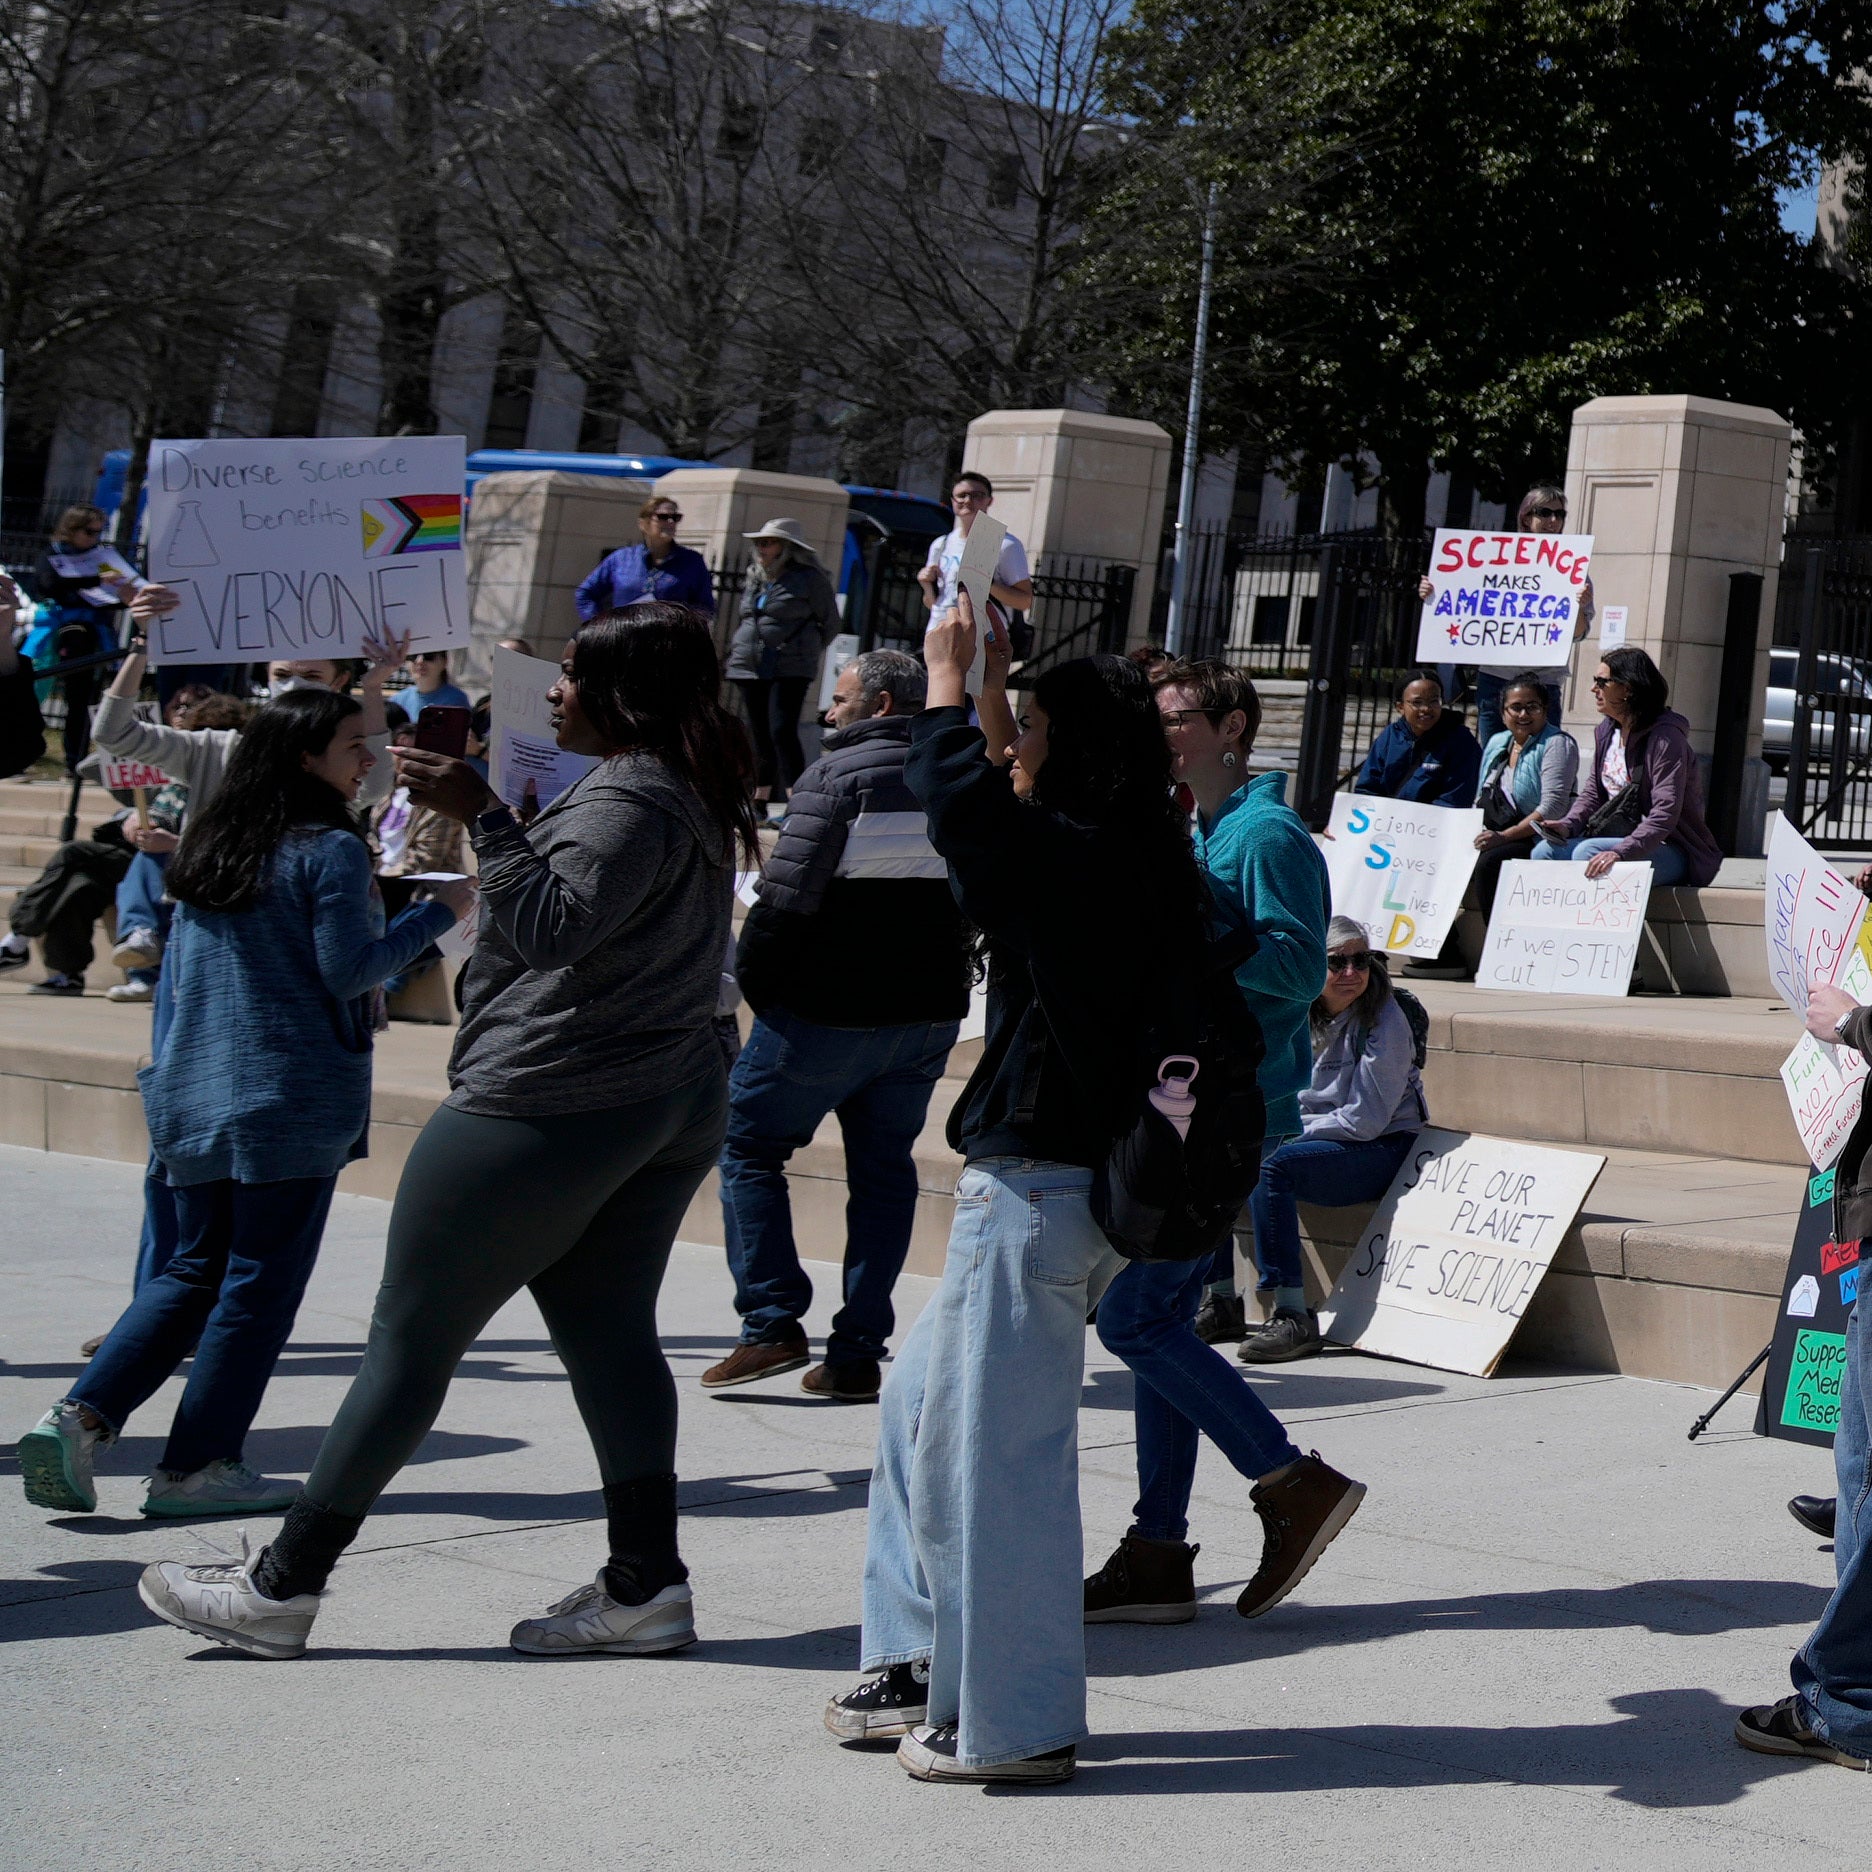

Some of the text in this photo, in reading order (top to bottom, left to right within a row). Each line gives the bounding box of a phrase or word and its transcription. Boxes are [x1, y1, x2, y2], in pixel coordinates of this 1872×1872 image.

[162, 448, 407, 492] Diverse science
[239, 499, 349, 531] benefits
[1437, 536, 1589, 585] SCIENCE
[1483, 575, 1541, 590] MAKES
[1434, 588, 1570, 620] AMERICA
[1462, 620, 1550, 646] GREAT!
[107, 762, 171, 788] LEGAL
[1347, 798, 1440, 838] Science
[1365, 833, 1437, 876] Saves
[1382, 870, 1438, 917] Lives
[1509, 874, 1641, 907] America First
[1577, 909, 1637, 927] LAST
[1494, 961, 1536, 986] cut
[1496, 928, 1635, 979] if we STEM
[1800, 1071, 1830, 1128] NOT
[1404, 1150, 1535, 1206] SAVE OUR
[1450, 1200, 1554, 1248] PLANET
[1357, 1234, 1547, 1318] SAVE SCIENCE
[1797, 1334, 1847, 1364] Suppo
